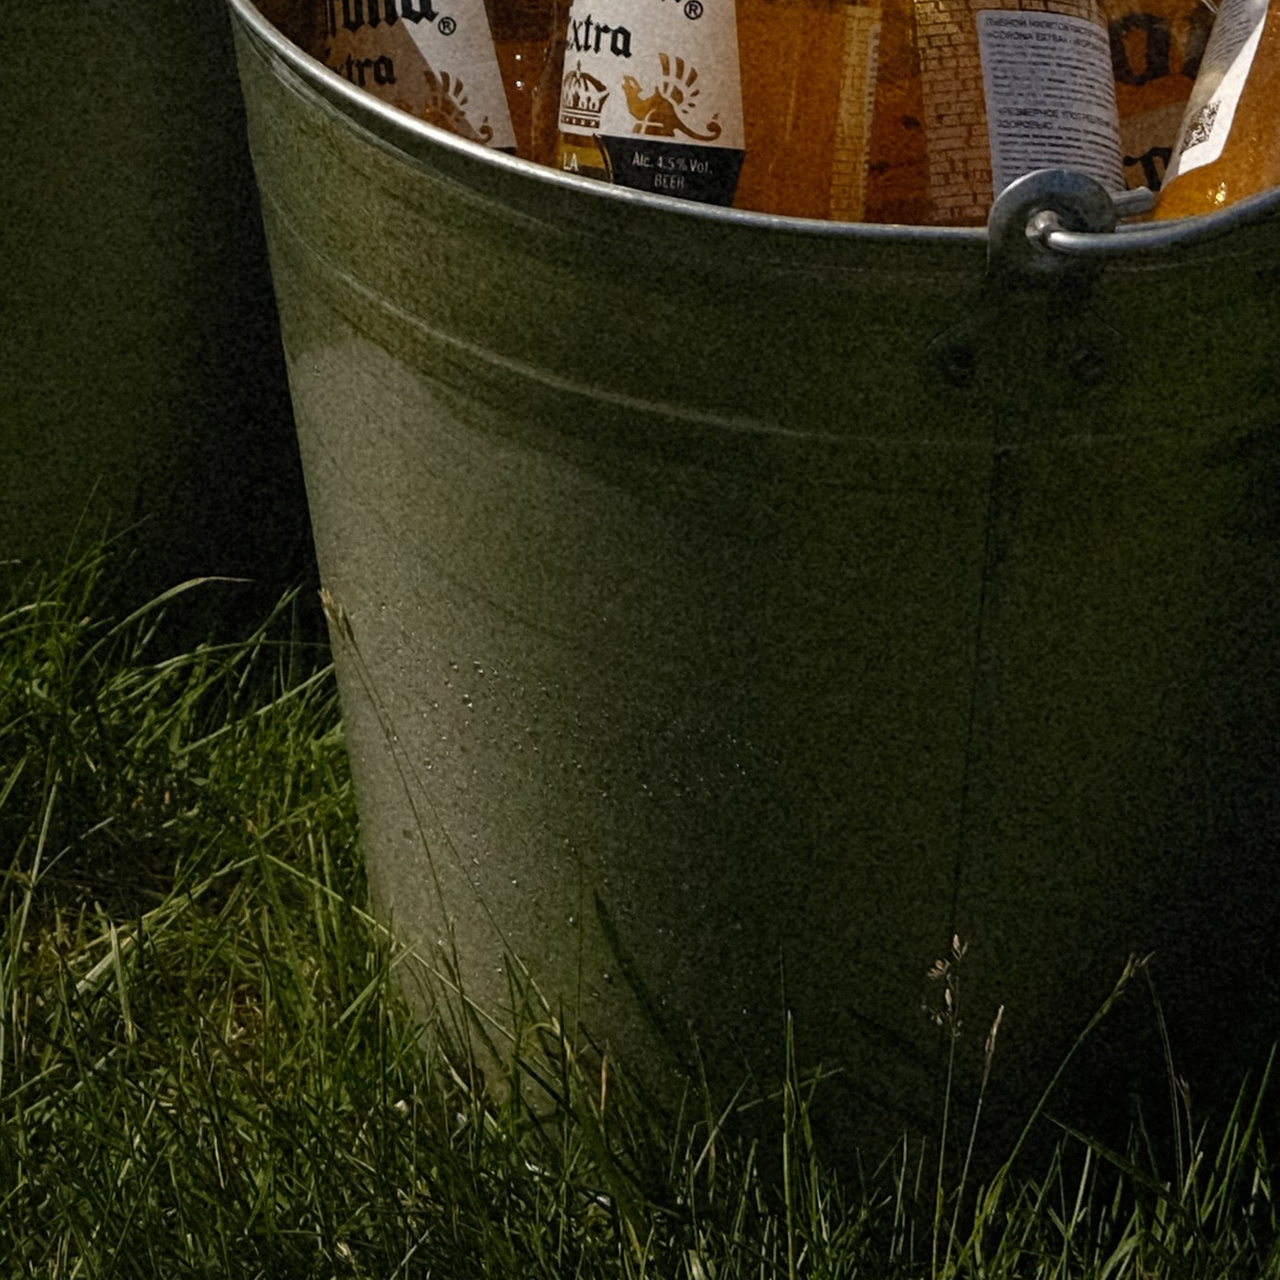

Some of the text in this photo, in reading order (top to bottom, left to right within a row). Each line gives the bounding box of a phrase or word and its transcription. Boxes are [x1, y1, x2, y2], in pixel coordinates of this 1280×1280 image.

[566, 13, 632, 58] xtra
[563, 151, 579, 172] LA
[654, 174, 685, 189] BEER
